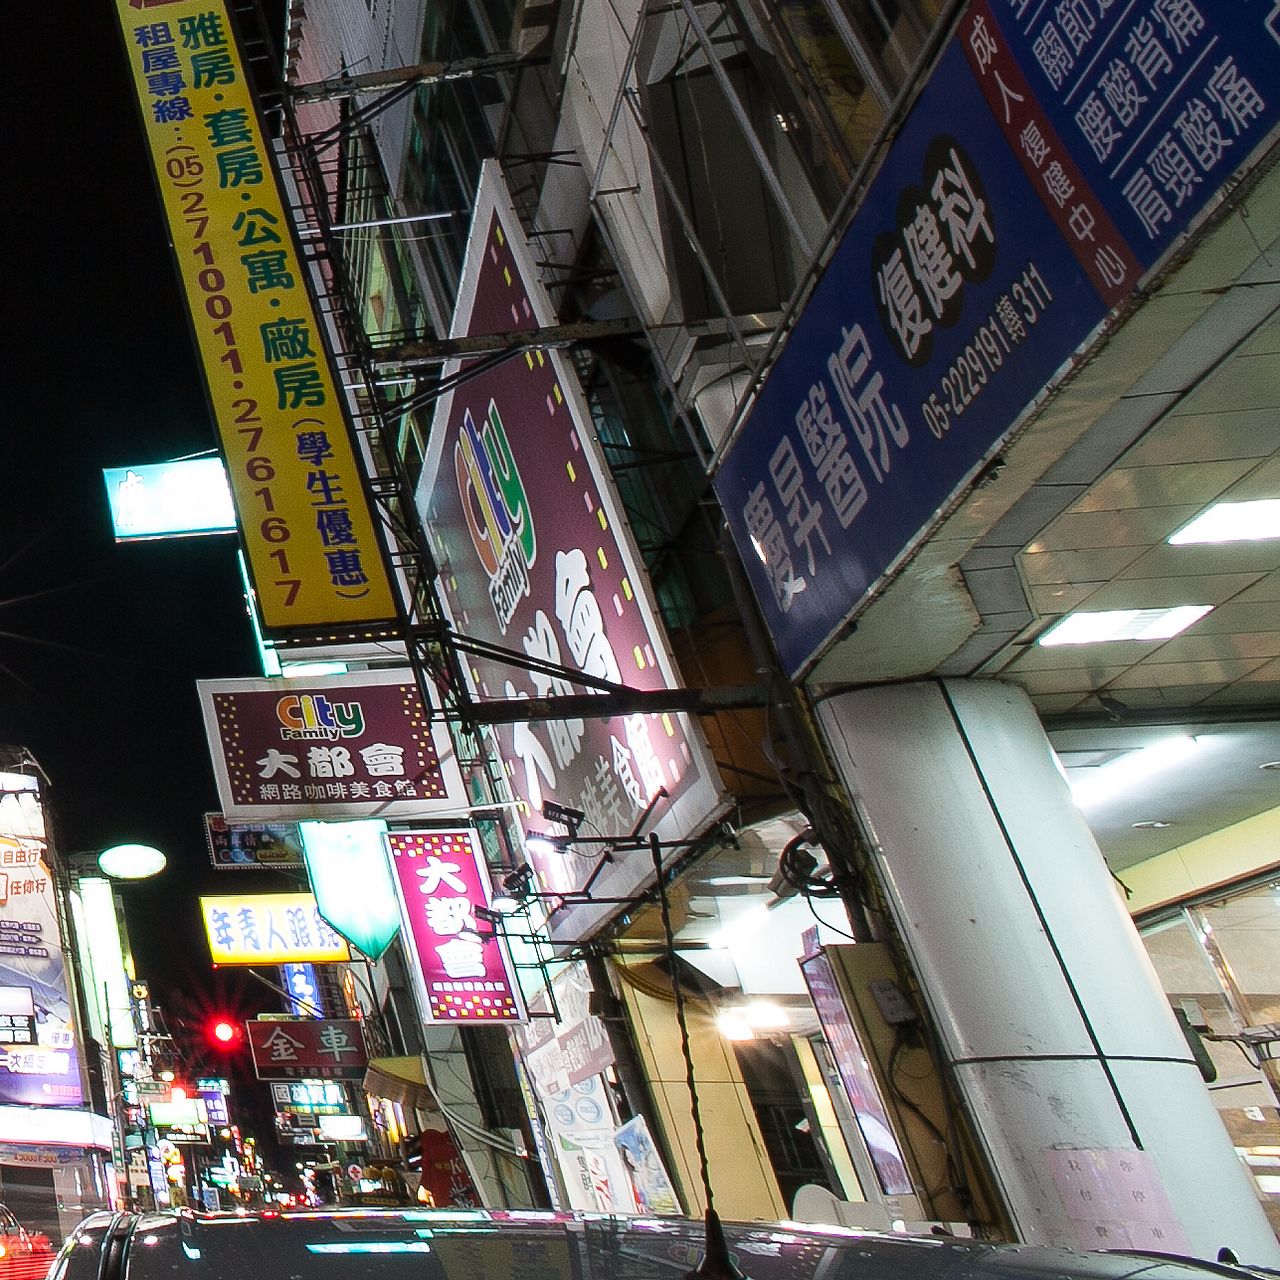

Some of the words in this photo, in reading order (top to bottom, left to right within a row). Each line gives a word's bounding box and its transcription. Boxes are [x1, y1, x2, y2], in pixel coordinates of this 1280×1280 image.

[967, 15, 1127, 289] 成人復健中心
[1121, 54, 1266, 241] 肩頸酸痛
[877, 148, 996, 360] 復健科
[744, 322, 908, 613] 慶昇醫院
[276, 694, 366, 739] City
[281, 727, 340, 741] Family
[256, 743, 406, 778] 大都會
[260, 779, 417, 801] 網路咖啡美食館
[4, 849, 40, 865] 自由行
[260, 1025, 358, 1061] 金車
